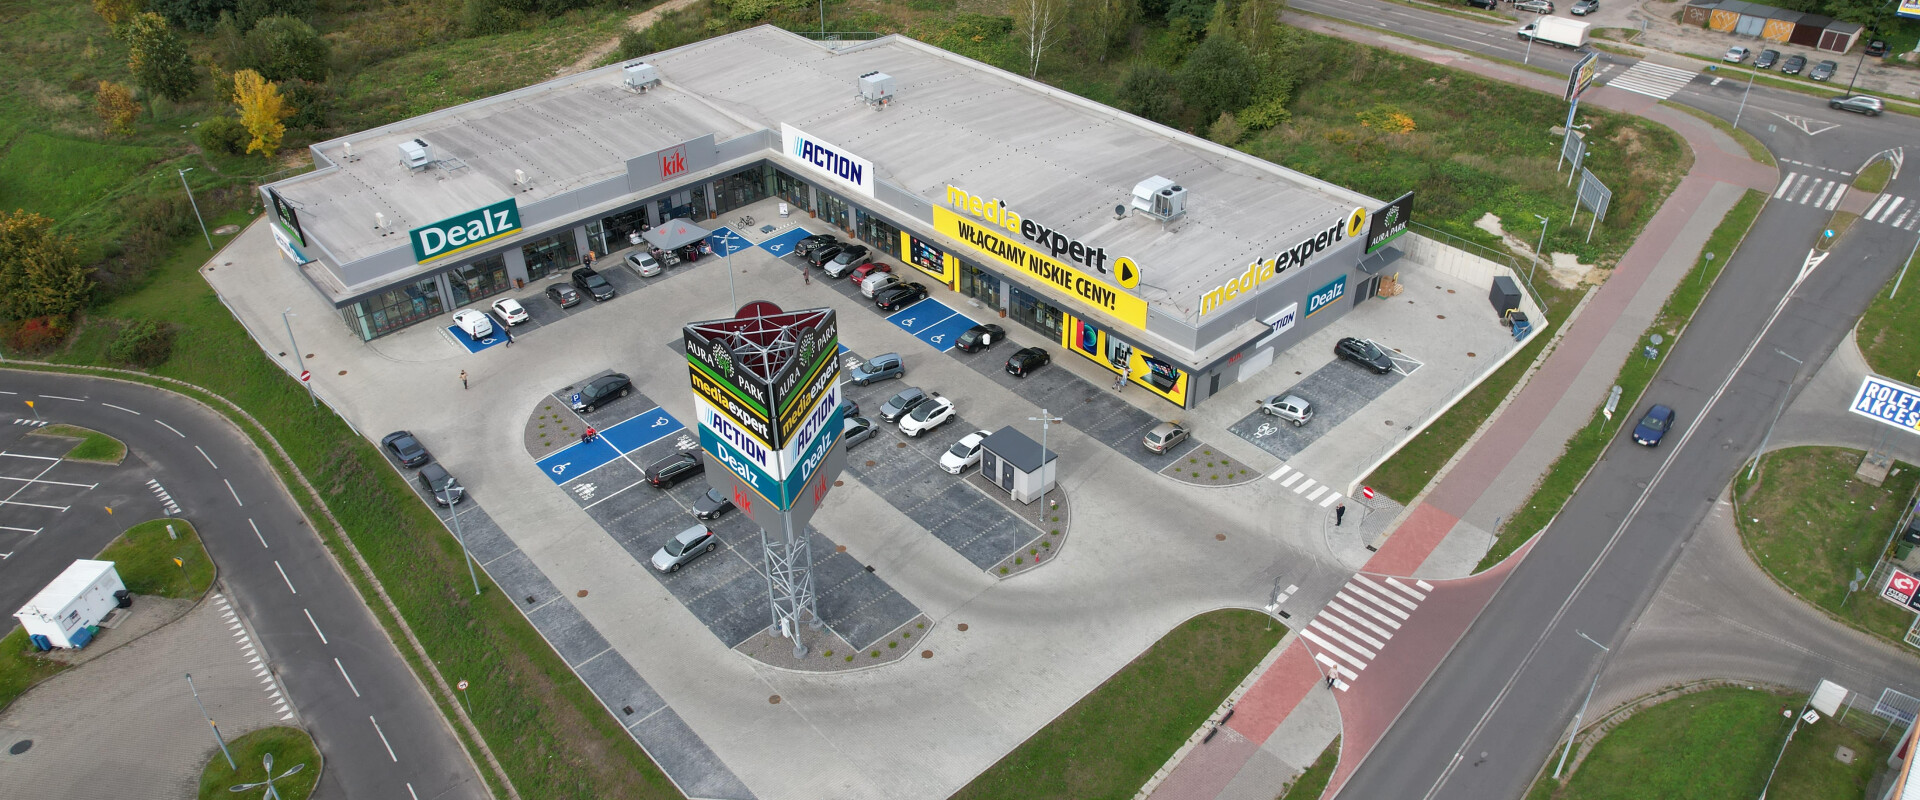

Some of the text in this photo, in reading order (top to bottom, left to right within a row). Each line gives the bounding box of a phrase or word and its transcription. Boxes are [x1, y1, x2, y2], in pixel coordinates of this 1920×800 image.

[663, 150, 686, 177] kik
[802, 140, 862, 186] ACTION
[418, 209, 514, 256] Dealz
[947, 184, 1108, 274] mediaexpert
[1371, 220, 1407, 247] AURA PARK
[958, 220, 1116, 310] WŁĄCZAMY NISKIE CENY!
[1200, 217, 1345, 316] mediaexpert
[1309, 281, 1343, 312] Dealz
[687, 339, 766, 405] AURA PARK
[779, 321, 836, 401] AURA PARK
[573, 394, 579, 402] P
[692, 373, 769, 440] mediaexpert
[782, 354, 839, 437] mediaexpert
[1866, 382, 1920, 411] ROLET
[712, 412, 767, 467] ACTION
[797, 388, 835, 456] ACTION
[717, 442, 760, 488] Dealz
[802, 431, 832, 482] Dealz
[734, 488, 752, 514] kik
[814, 475, 828, 505] kik
